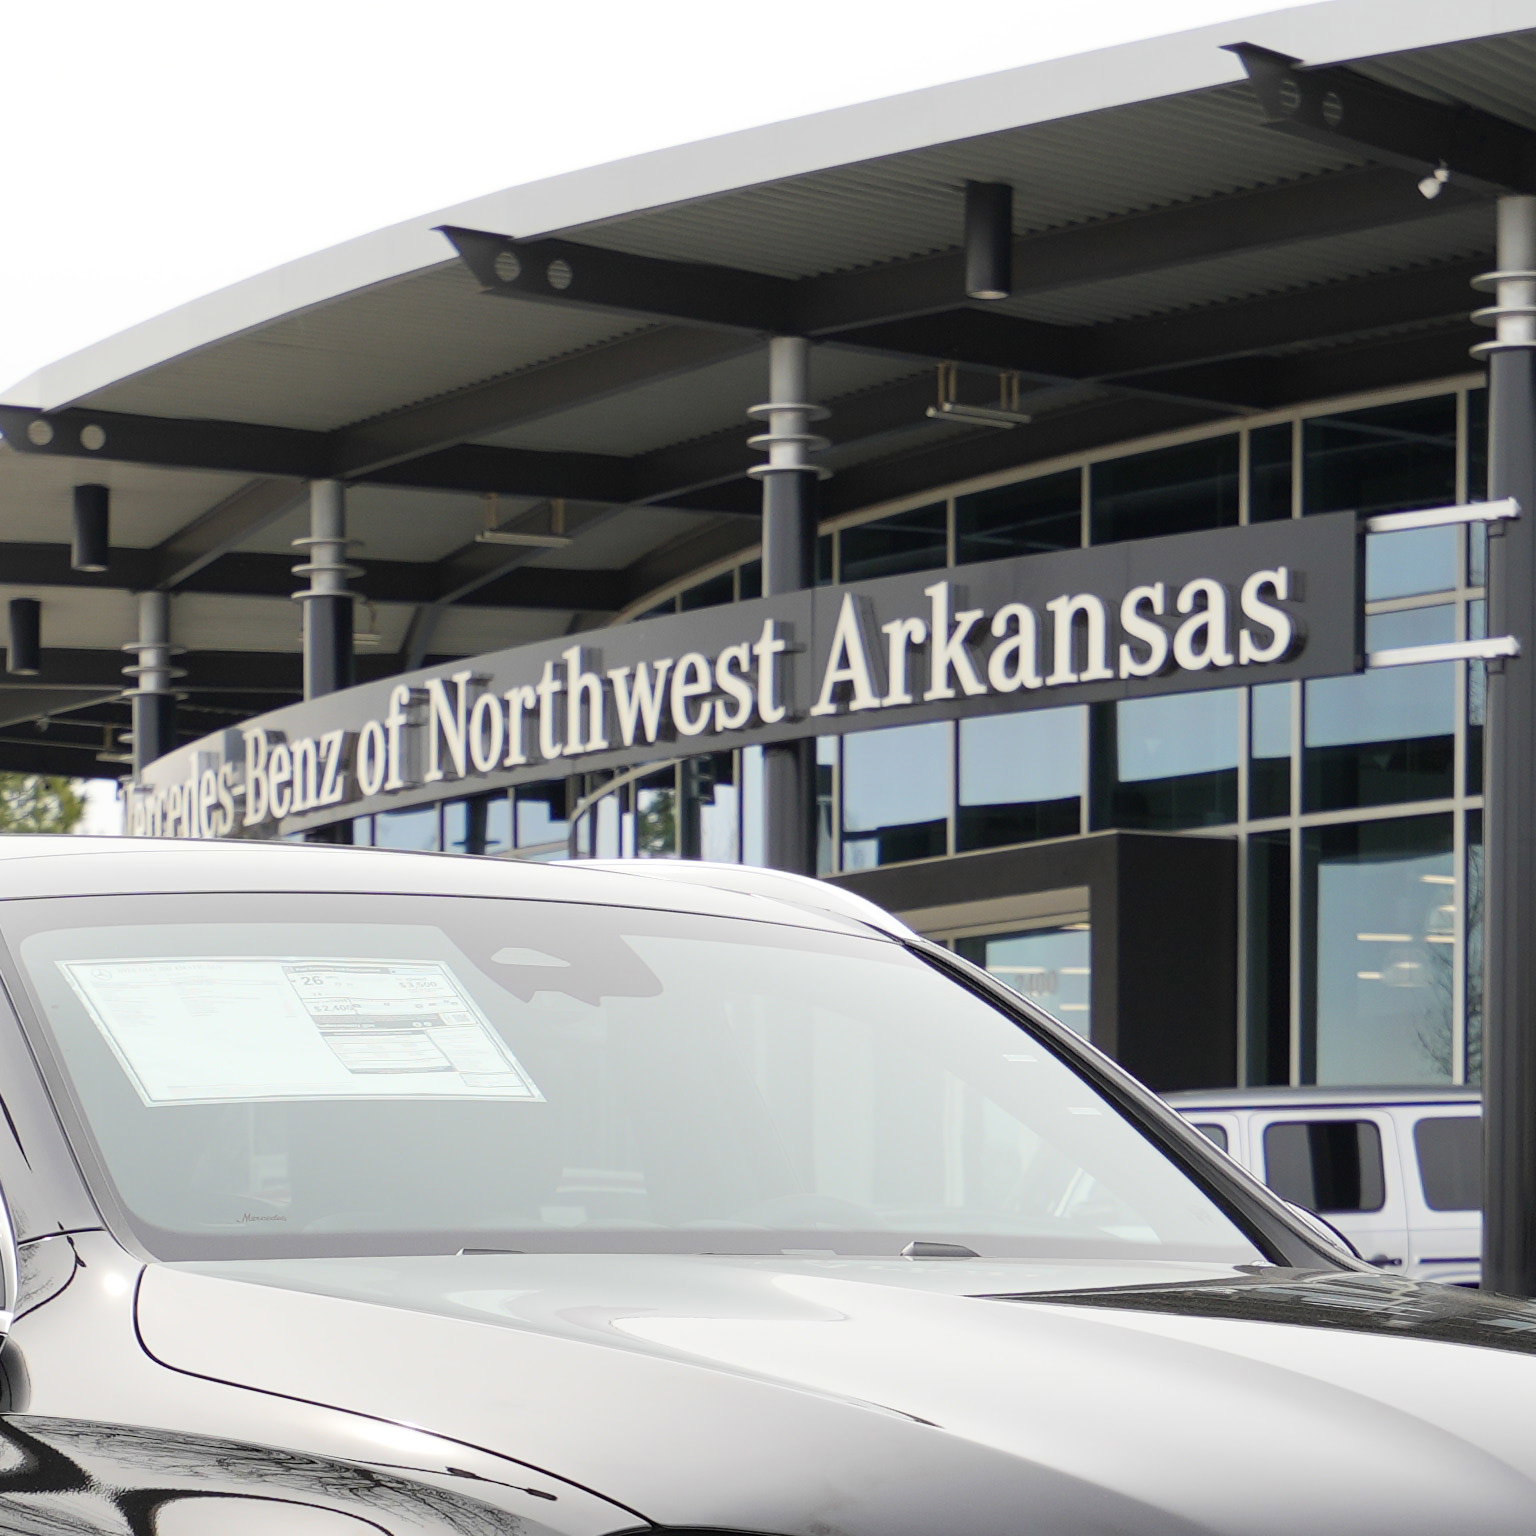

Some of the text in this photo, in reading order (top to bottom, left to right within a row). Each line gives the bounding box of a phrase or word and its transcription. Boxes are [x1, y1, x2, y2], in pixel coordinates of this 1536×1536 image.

[357, 685, 410, 796] of
[424, 619, 786, 783] Northwest
[811, 566, 1292, 716] Arkansas
